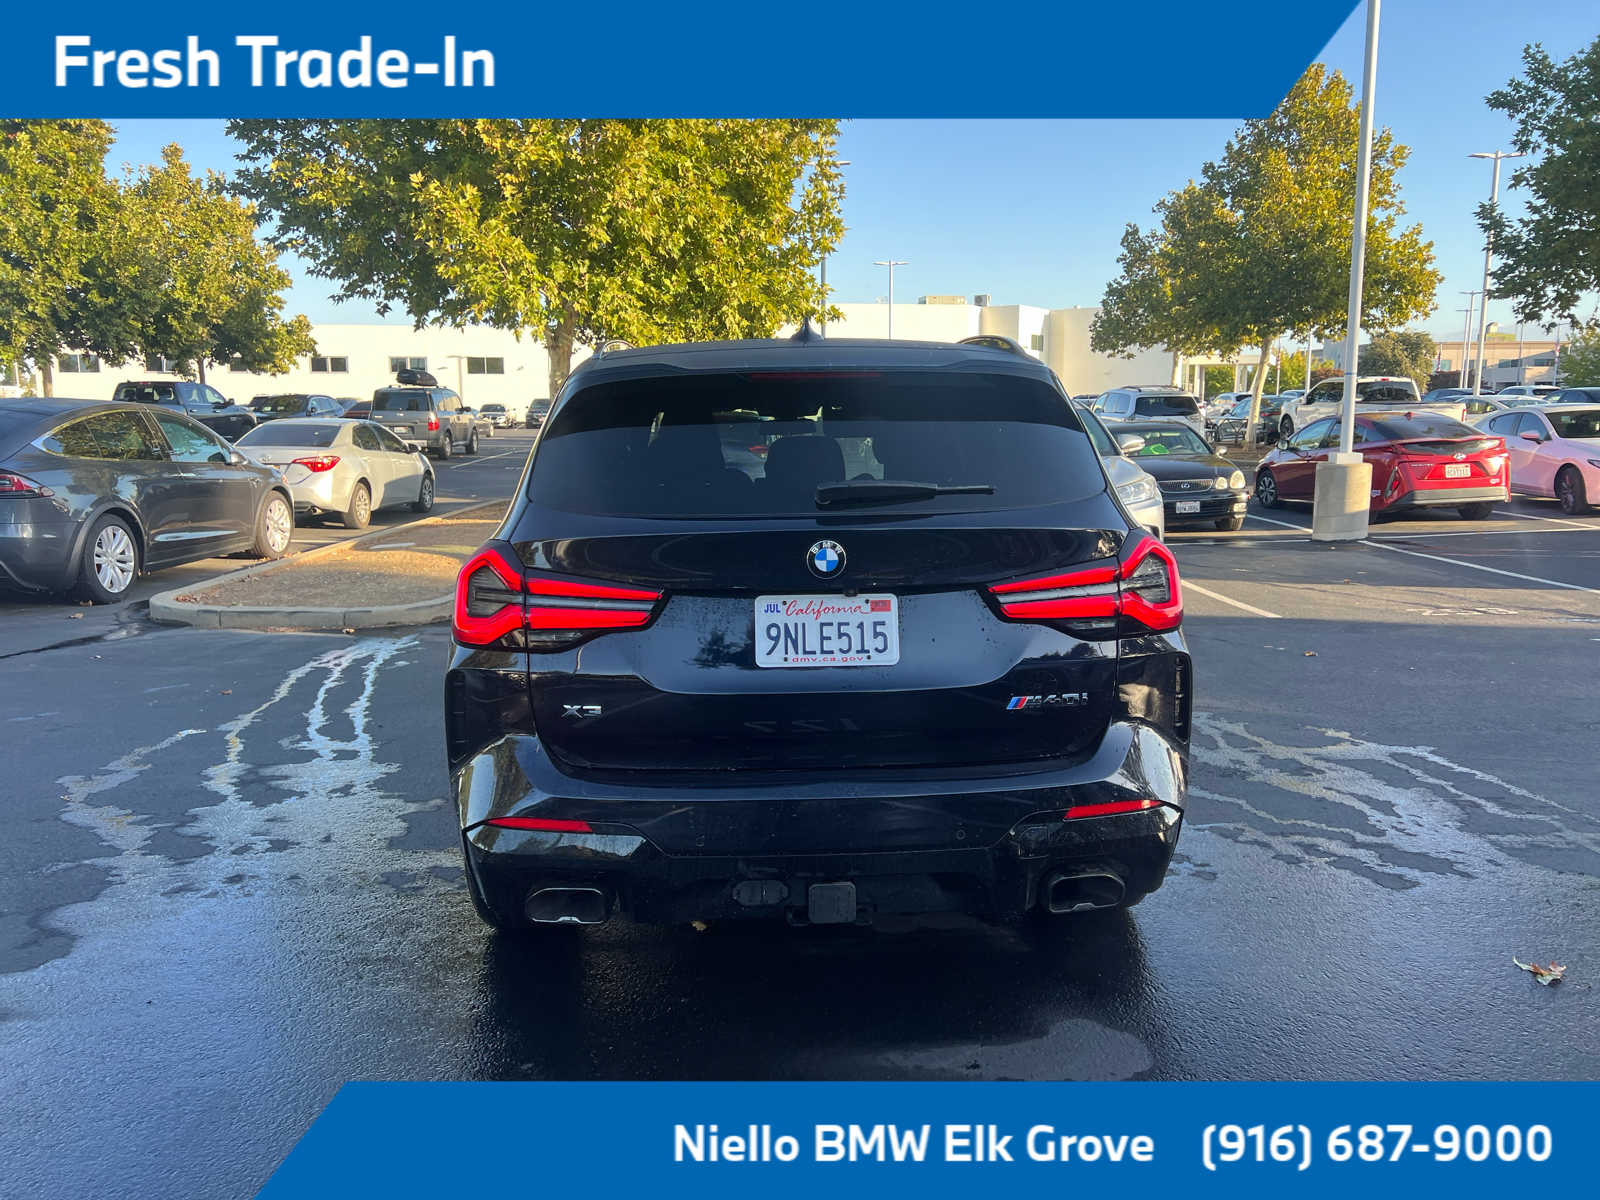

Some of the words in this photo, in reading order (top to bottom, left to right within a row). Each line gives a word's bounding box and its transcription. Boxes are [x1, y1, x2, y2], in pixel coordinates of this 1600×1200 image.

[810, 540, 843, 554] BMW
[764, 603, 781, 614] JUL
[785, 600, 871, 620] California
[766, 621, 888, 656] 9NLE515
[792, 656, 864, 664] dmv.ca.gov
[561, 703, 602, 719] X3
